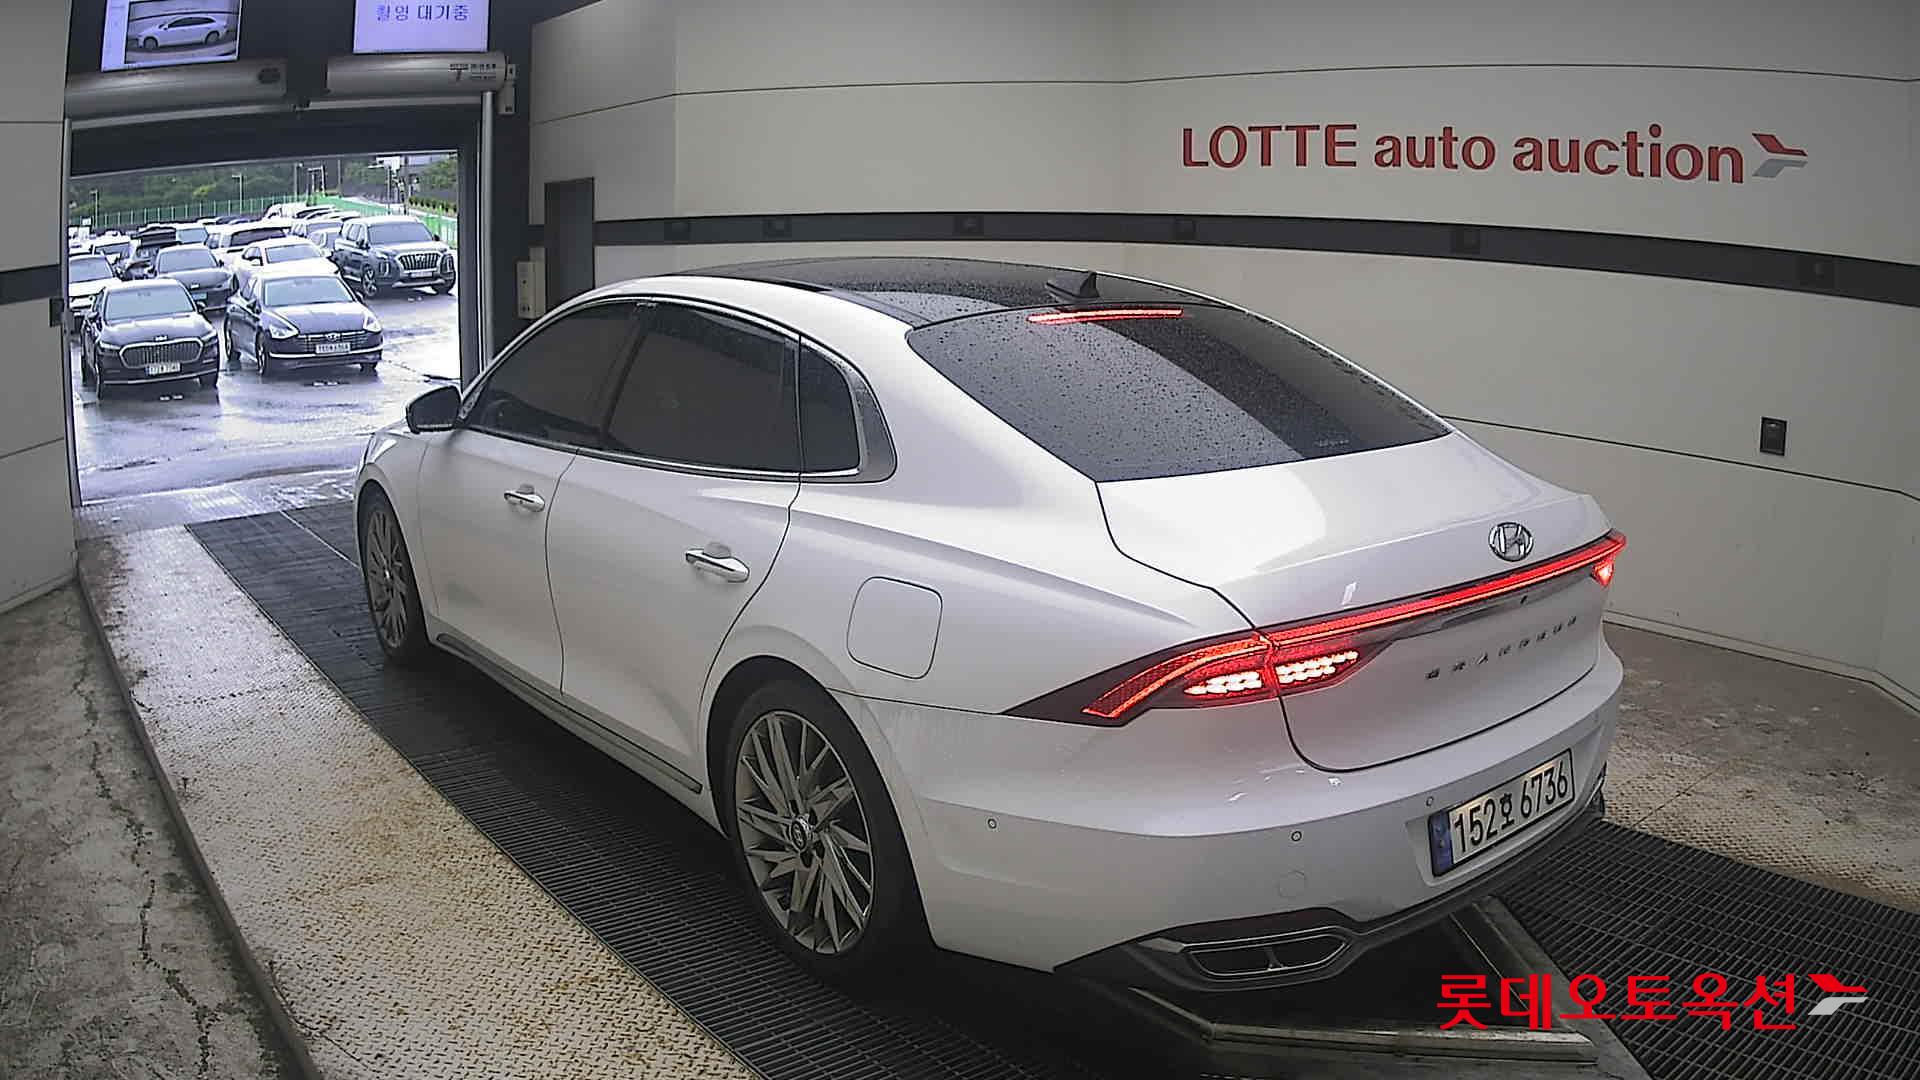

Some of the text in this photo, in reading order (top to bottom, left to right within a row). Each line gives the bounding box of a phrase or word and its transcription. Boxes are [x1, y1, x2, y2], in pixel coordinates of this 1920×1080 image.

[417, 4, 470, 21] 대기중
[1182, 123, 1744, 185] LOTTE auto auction
[1453, 760, 1569, 852] 152호 6736
